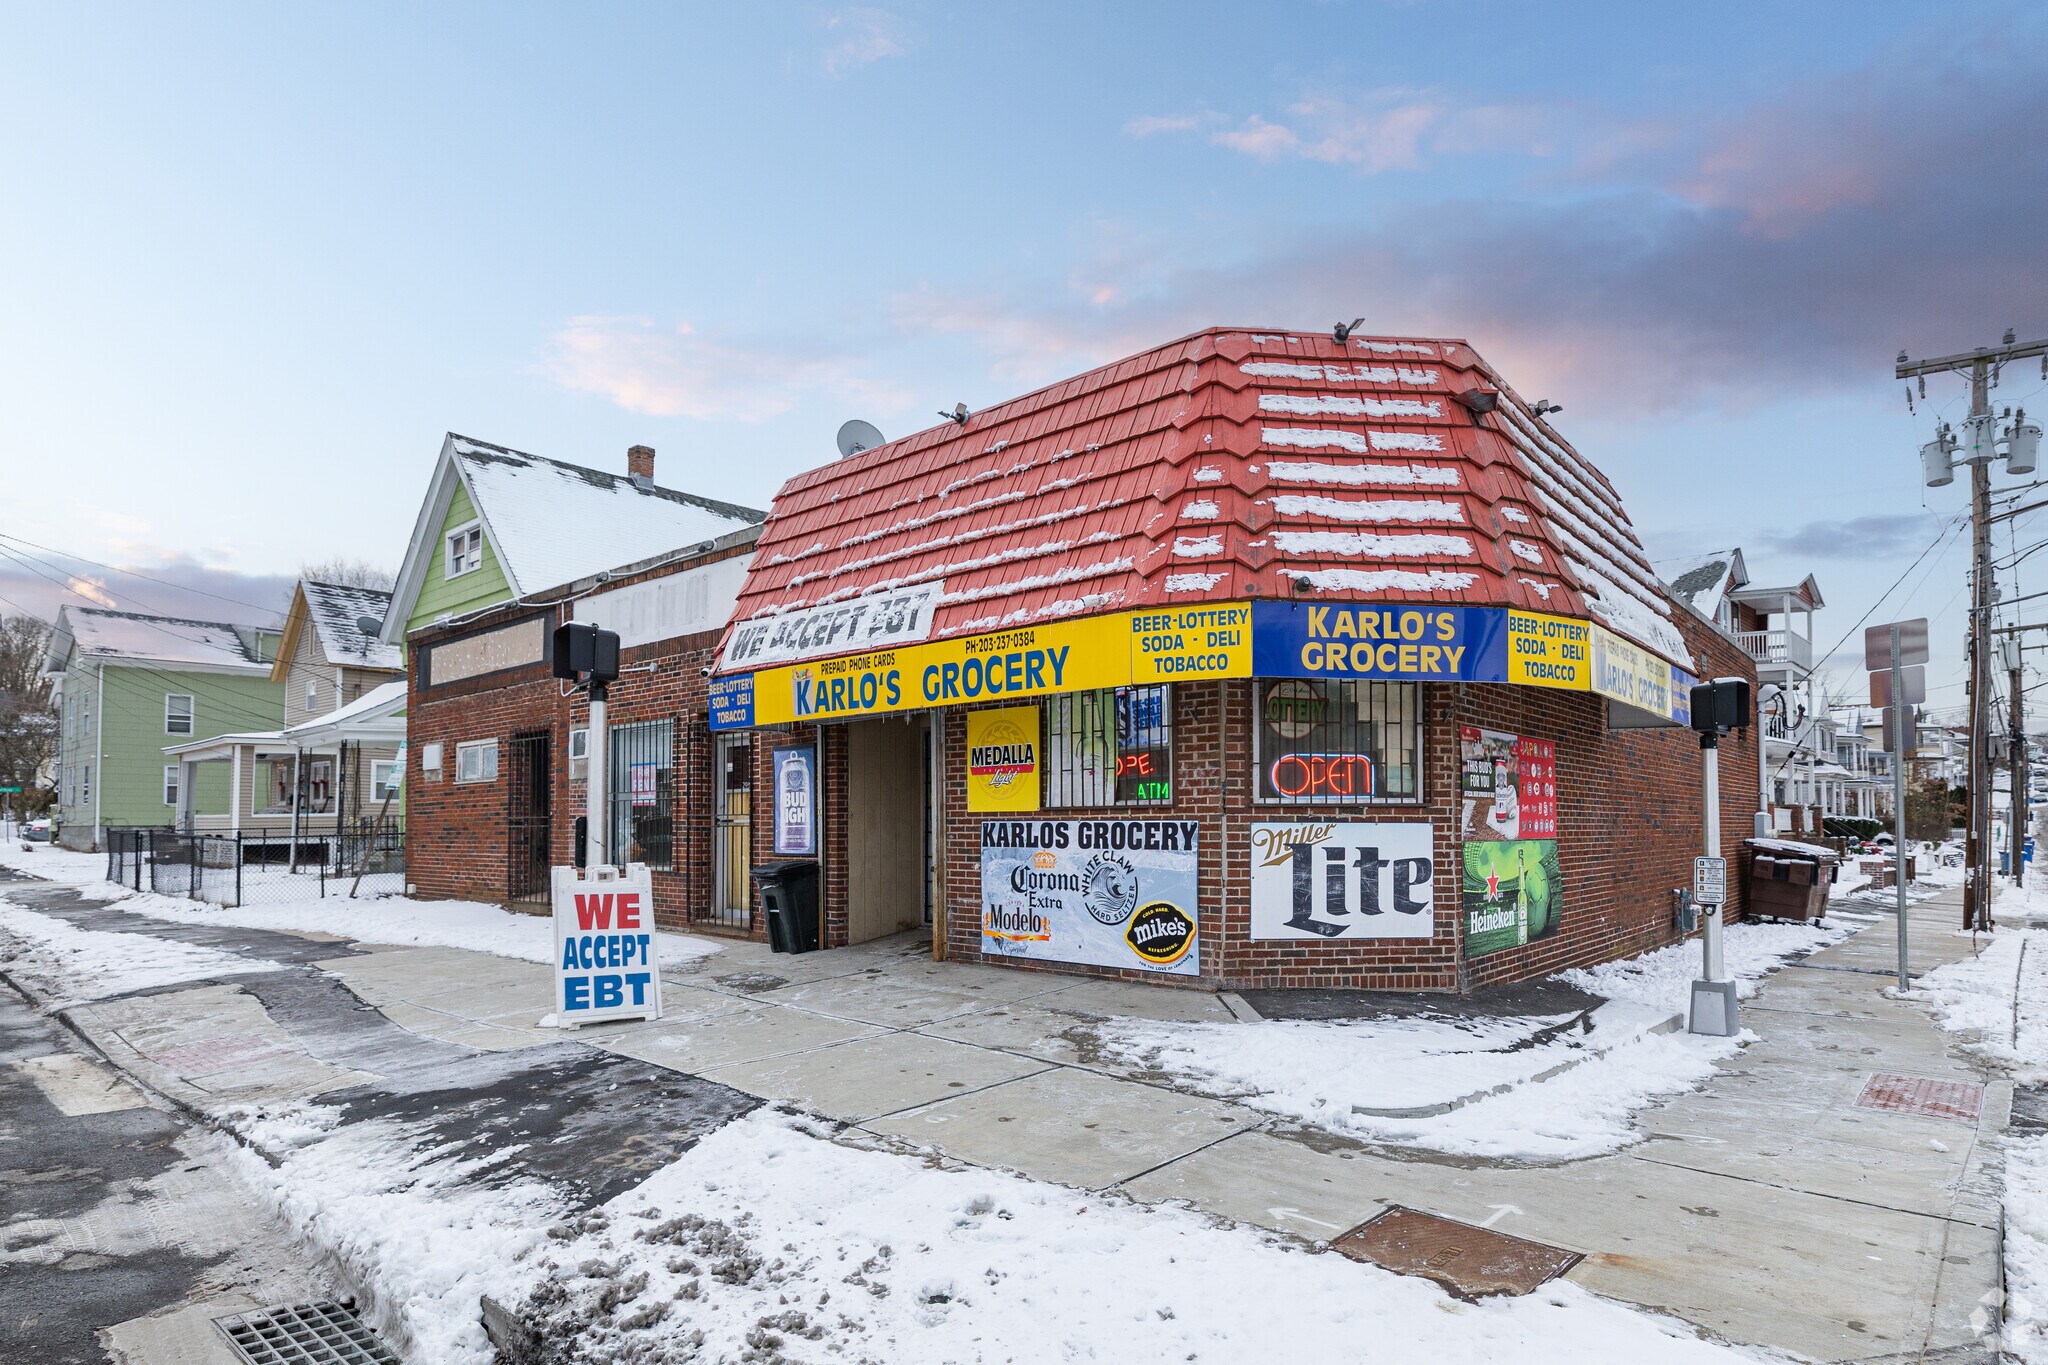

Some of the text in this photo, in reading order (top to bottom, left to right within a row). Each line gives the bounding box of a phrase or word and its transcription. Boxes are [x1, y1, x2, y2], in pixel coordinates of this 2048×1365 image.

[731, 624, 768, 662] WE
[769, 604, 868, 651] ACCEPT
[1132, 608, 1249, 633] BEER-LOTTERY
[1308, 606, 1456, 641] KARLO'S
[1509, 616, 1590, 642] BEER-LOTTERY
[965, 631, 1035, 654] PH-203-237-0384
[1141, 634, 1184, 653] SODA
[1206, 630, 1240, 648] DELI
[1516, 637, 1584, 661] SODA DELI
[821, 652, 895, 675] PREPAID PHONE CARDS
[1154, 653, 1229, 674] TOBACCO
[1301, 641, 1466, 674] GROCERY
[797, 645, 1070, 716] KARLO'S GROCERY
[1524, 661, 1576, 682] TOBACCO
[1599, 652, 1634, 700] KARLO'S
[1638, 676, 1670, 712] GROCERY
[709, 677, 754, 696] BEER-LOTTERY
[712, 692, 751, 709] SODA DELI
[1261, 696, 1326, 722] LOTTERY
[716, 708, 746, 724] TOBACCO
[970, 743, 1036, 768] MEDALLA
[1467, 760, 1479, 773] THIS
[988, 768, 1019, 788] Light
[1273, 756, 1371, 795] OPEN
[1470, 774, 1480, 787] FOR
[785, 791, 807, 807] BUD
[1138, 782, 1169, 800] ATM
[982, 822, 1199, 850] KARLOS GROCERY
[1252, 823, 1338, 862] Miller
[1011, 865, 1080, 896] Corona
[1081, 850, 1135, 898] WHITE CLAW
[1028, 891, 1063, 909] Extra
[1283, 843, 1432, 937] Lite
[574, 893, 641, 931] WE
[1091, 885, 1135, 922] HARD SELTZER
[990, 903, 1041, 933] Modelo
[1134, 916, 1187, 946] mike's
[1470, 907, 1515, 934] Heineken
[562, 934, 650, 970] ACCEPT
[564, 972, 651, 1011] EBT
